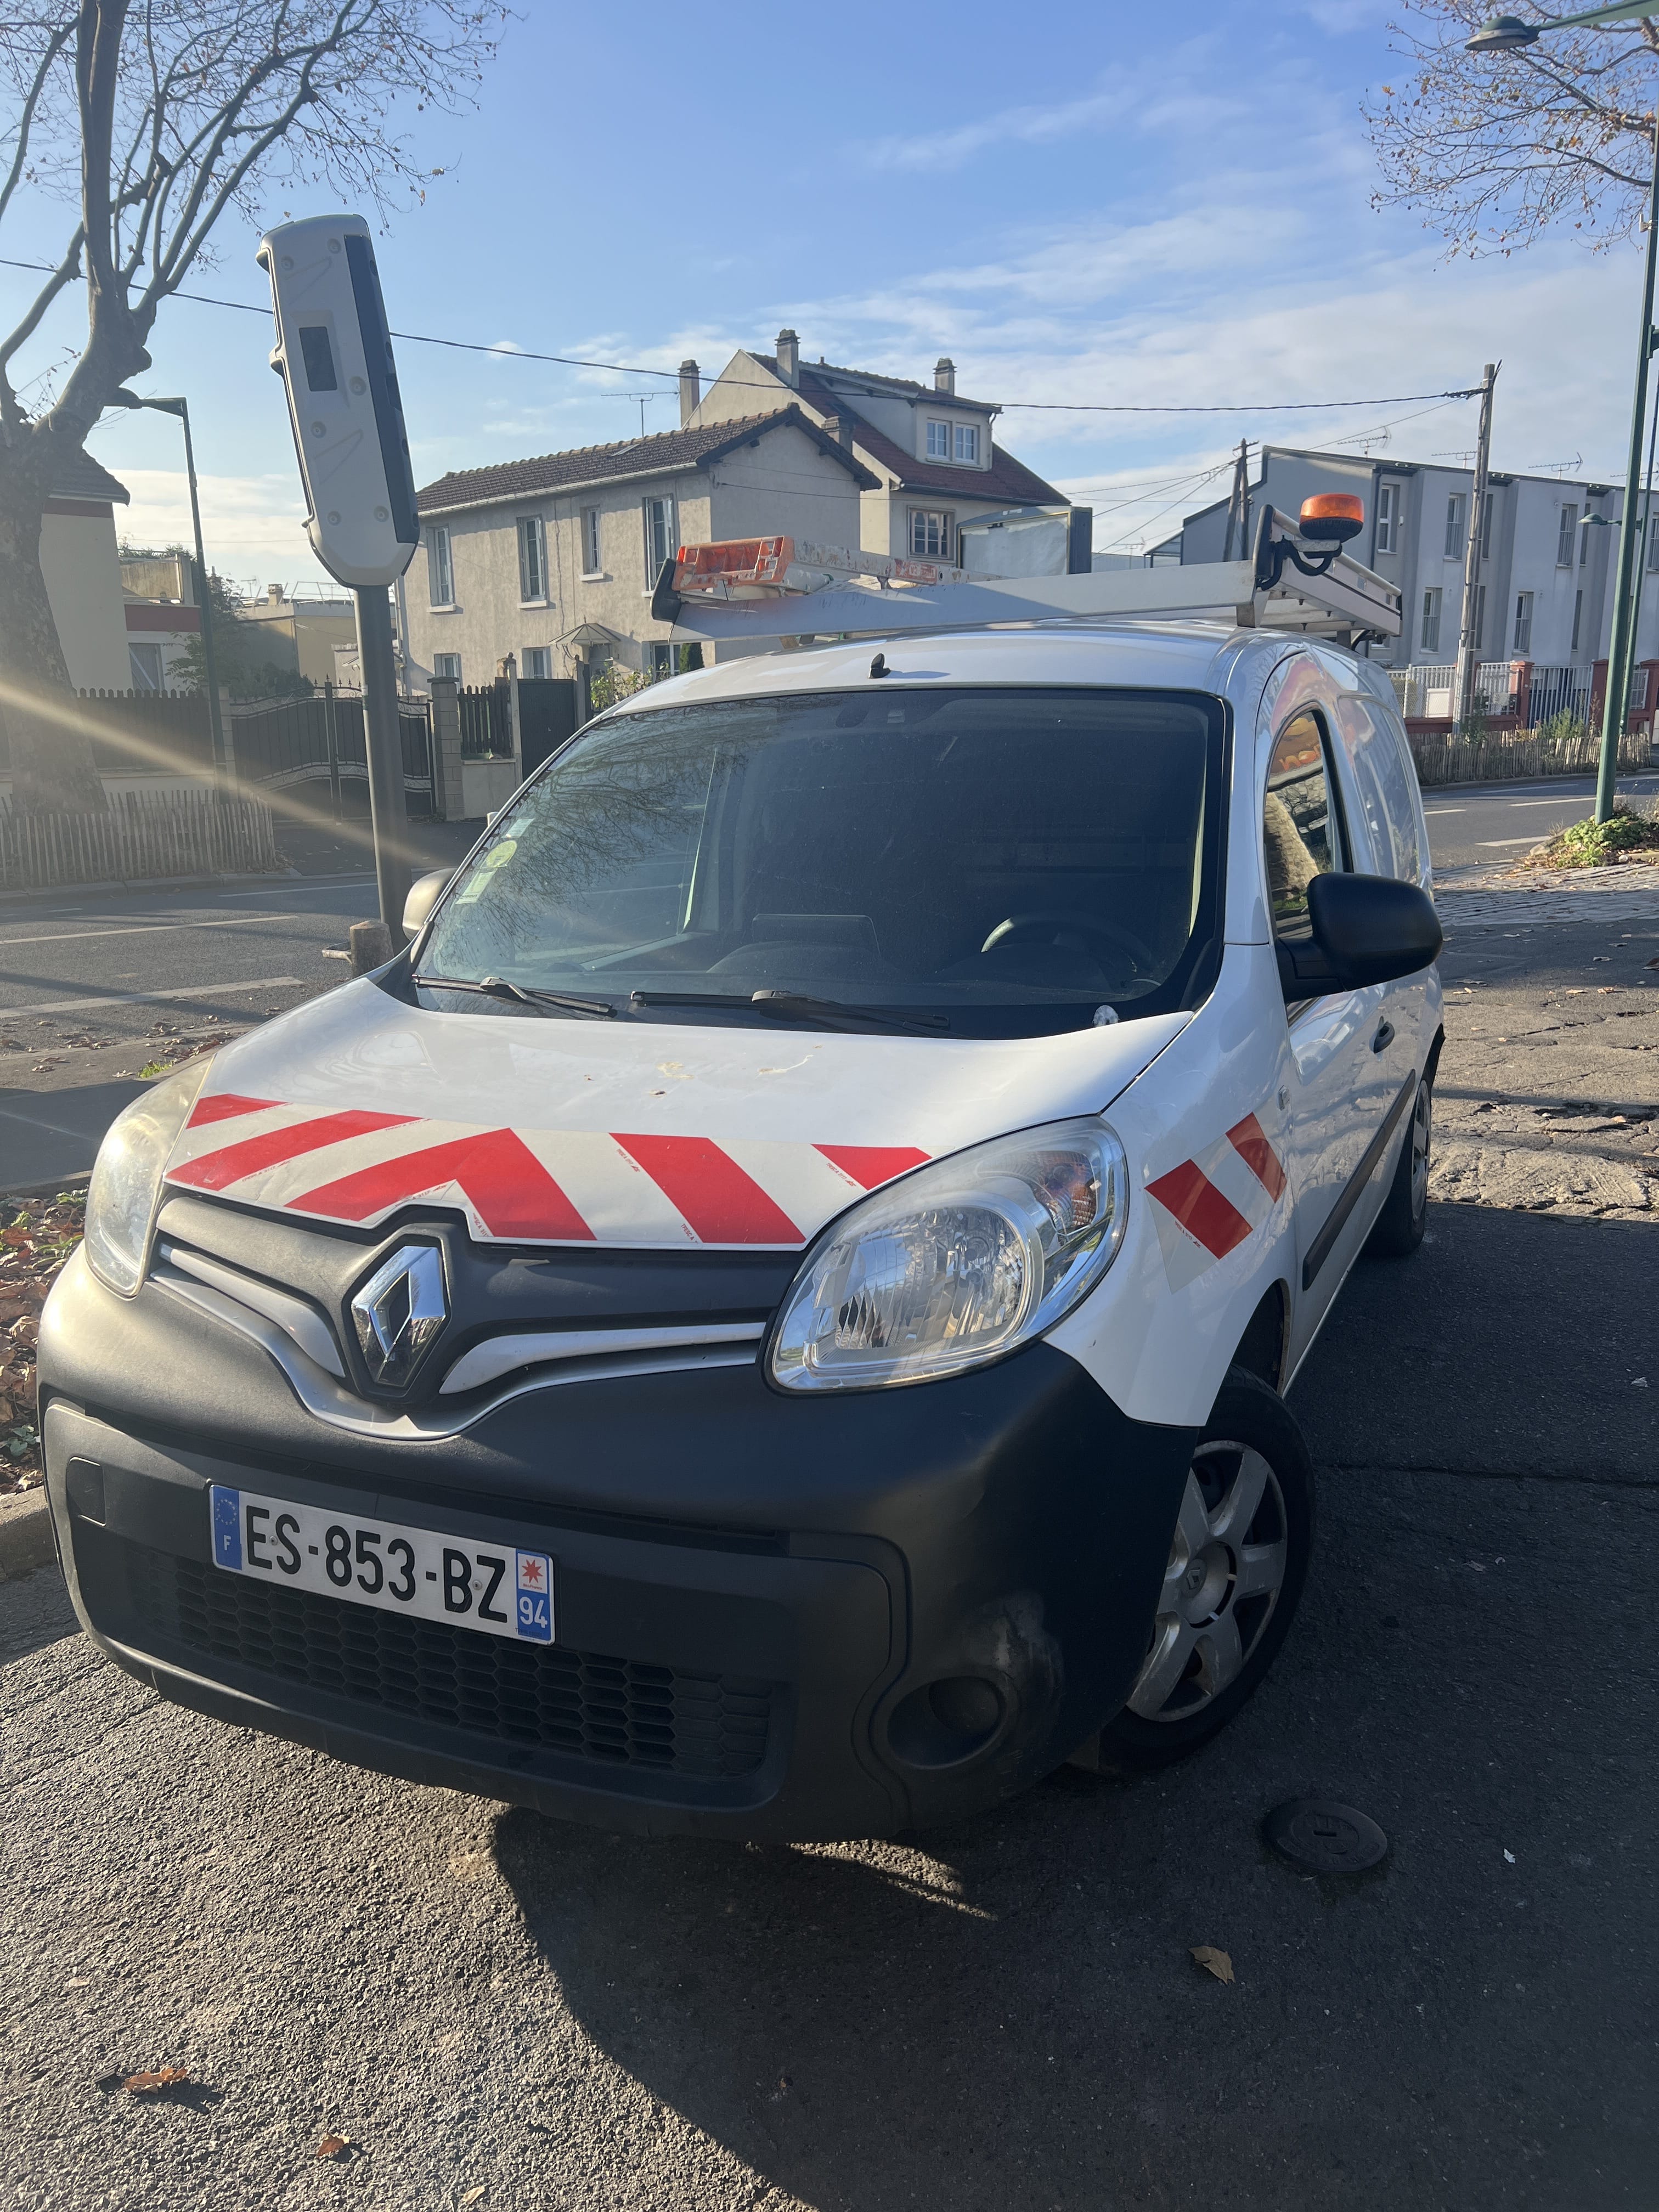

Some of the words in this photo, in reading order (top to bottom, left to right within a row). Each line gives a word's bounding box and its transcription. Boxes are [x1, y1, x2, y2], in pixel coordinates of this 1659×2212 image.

[224, 1535, 232, 1551] F
[246, 1505, 507, 1623] ES-853-BZ
[519, 1596, 548, 1629] 94
